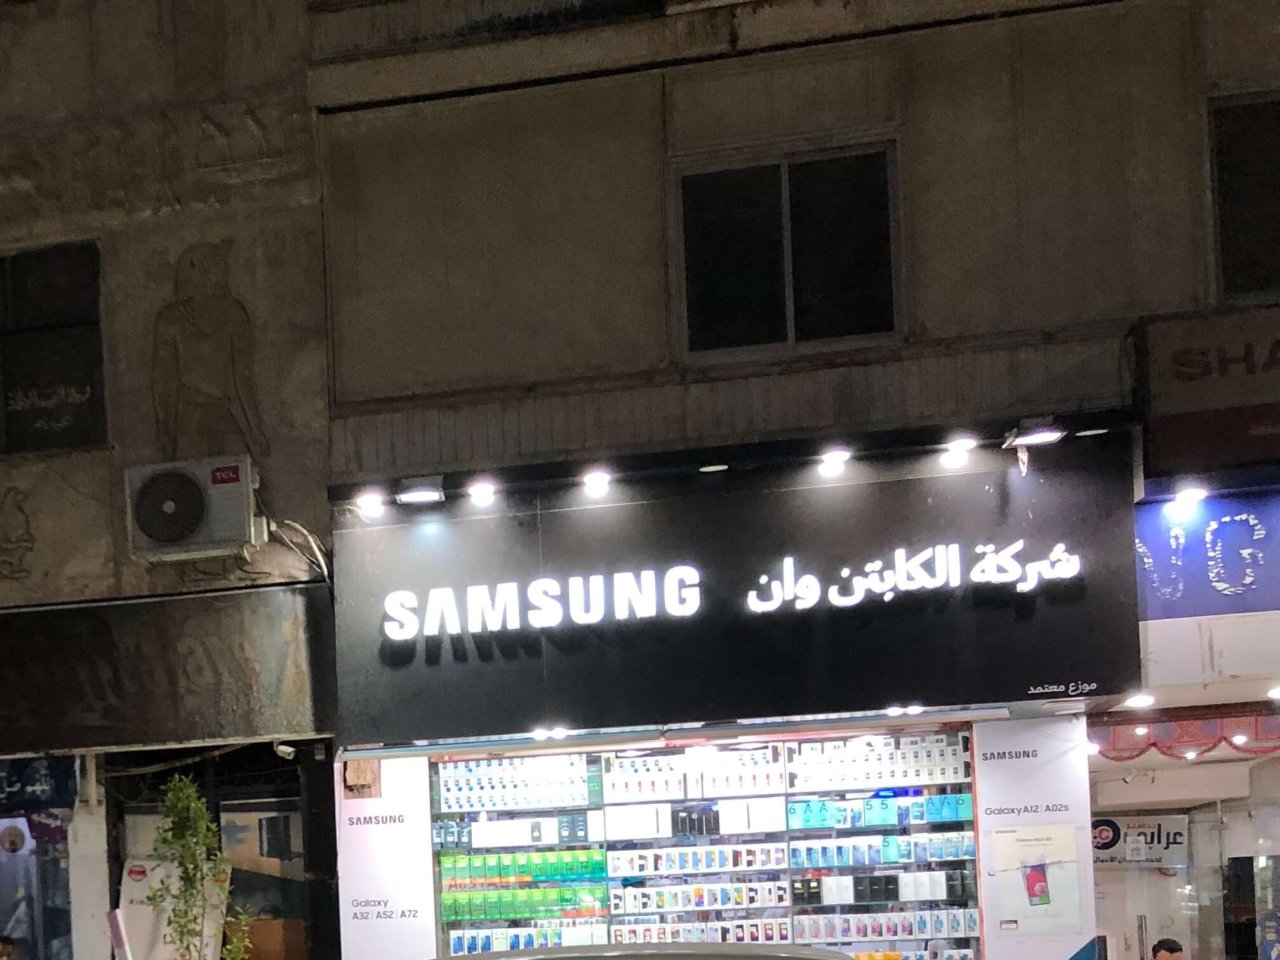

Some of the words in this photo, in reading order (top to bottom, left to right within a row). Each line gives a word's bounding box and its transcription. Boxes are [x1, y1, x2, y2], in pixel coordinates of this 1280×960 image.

[970, 539, 1081, 593] شركة
[827, 543, 961, 608] الكابتن
[746, 556, 821, 613] وان
[383, 564, 702, 641] SAMSUNG
[1027, 684, 1066, 694] معتمد
[1068, 681, 1097, 695] موزع
[981, 749, 1038, 762] SAMSUNG
[865, 799, 873, 810] 5
[880, 799, 888, 810] 5
[984, 806, 1022, 816] Galaxy
[1023, 805, 1039, 813] A12
[1044, 803, 1070, 812] A02s
[348, 815, 405, 826] SAMSUNG
[882, 837, 890, 848] 5
[351, 899, 389, 908] Galaxy
[352, 912, 370, 920] A32
[376, 911, 394, 919] A52
[400, 910, 418, 918] A72
